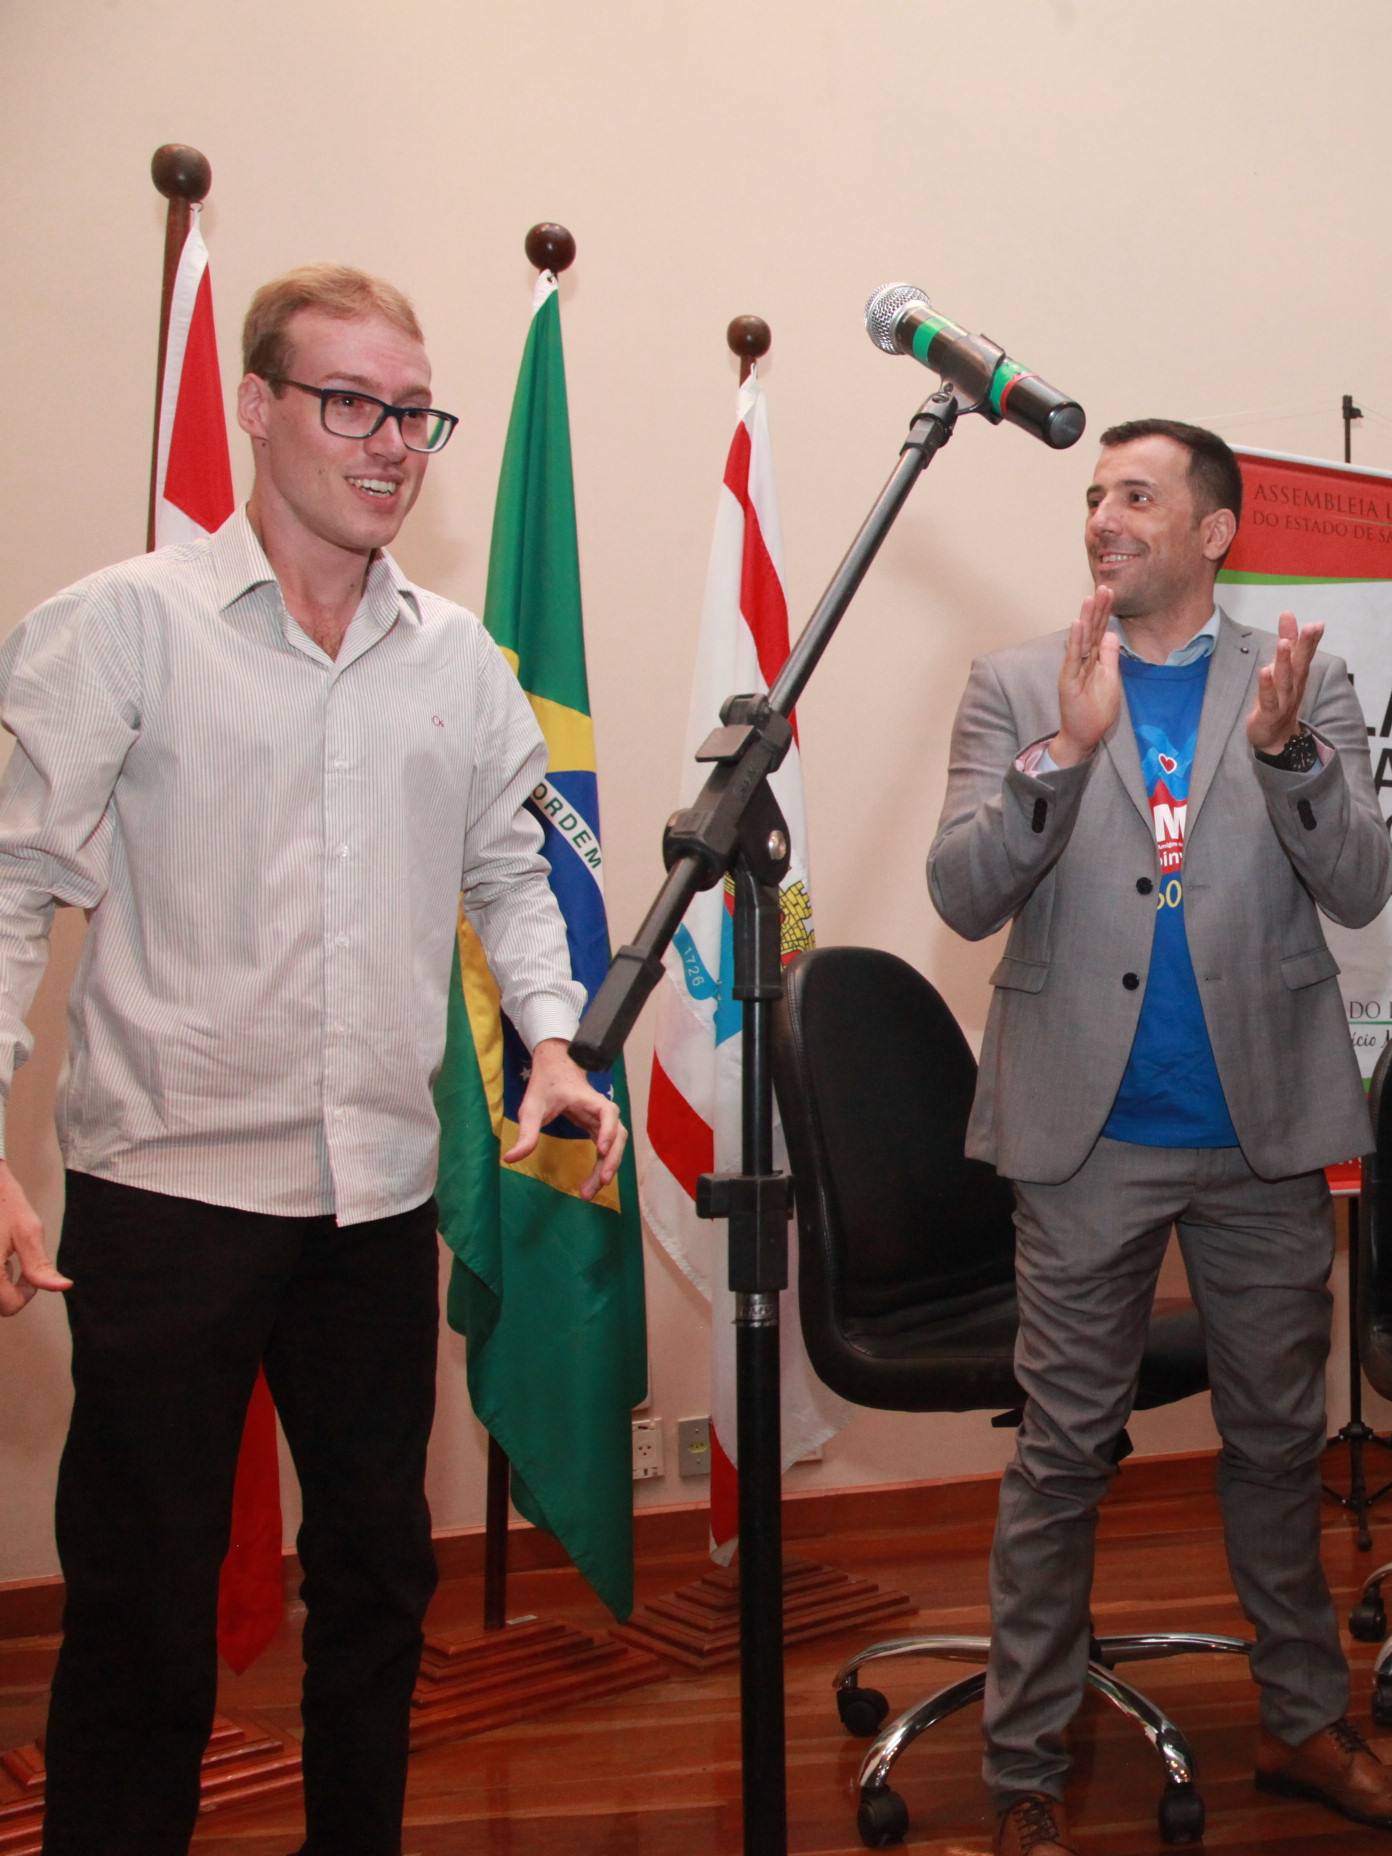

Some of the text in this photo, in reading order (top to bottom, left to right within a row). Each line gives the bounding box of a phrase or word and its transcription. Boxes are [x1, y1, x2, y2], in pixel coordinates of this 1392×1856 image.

[1254, 482, 1379, 519] ASSEMBLEIA
[1252, 510, 1279, 528] DO
[1285, 515, 1348, 537] ESTADO
[1353, 524, 1374, 541] DE
[532, 782, 602, 869] ORDEM
[683, 947, 705, 987] 1726
